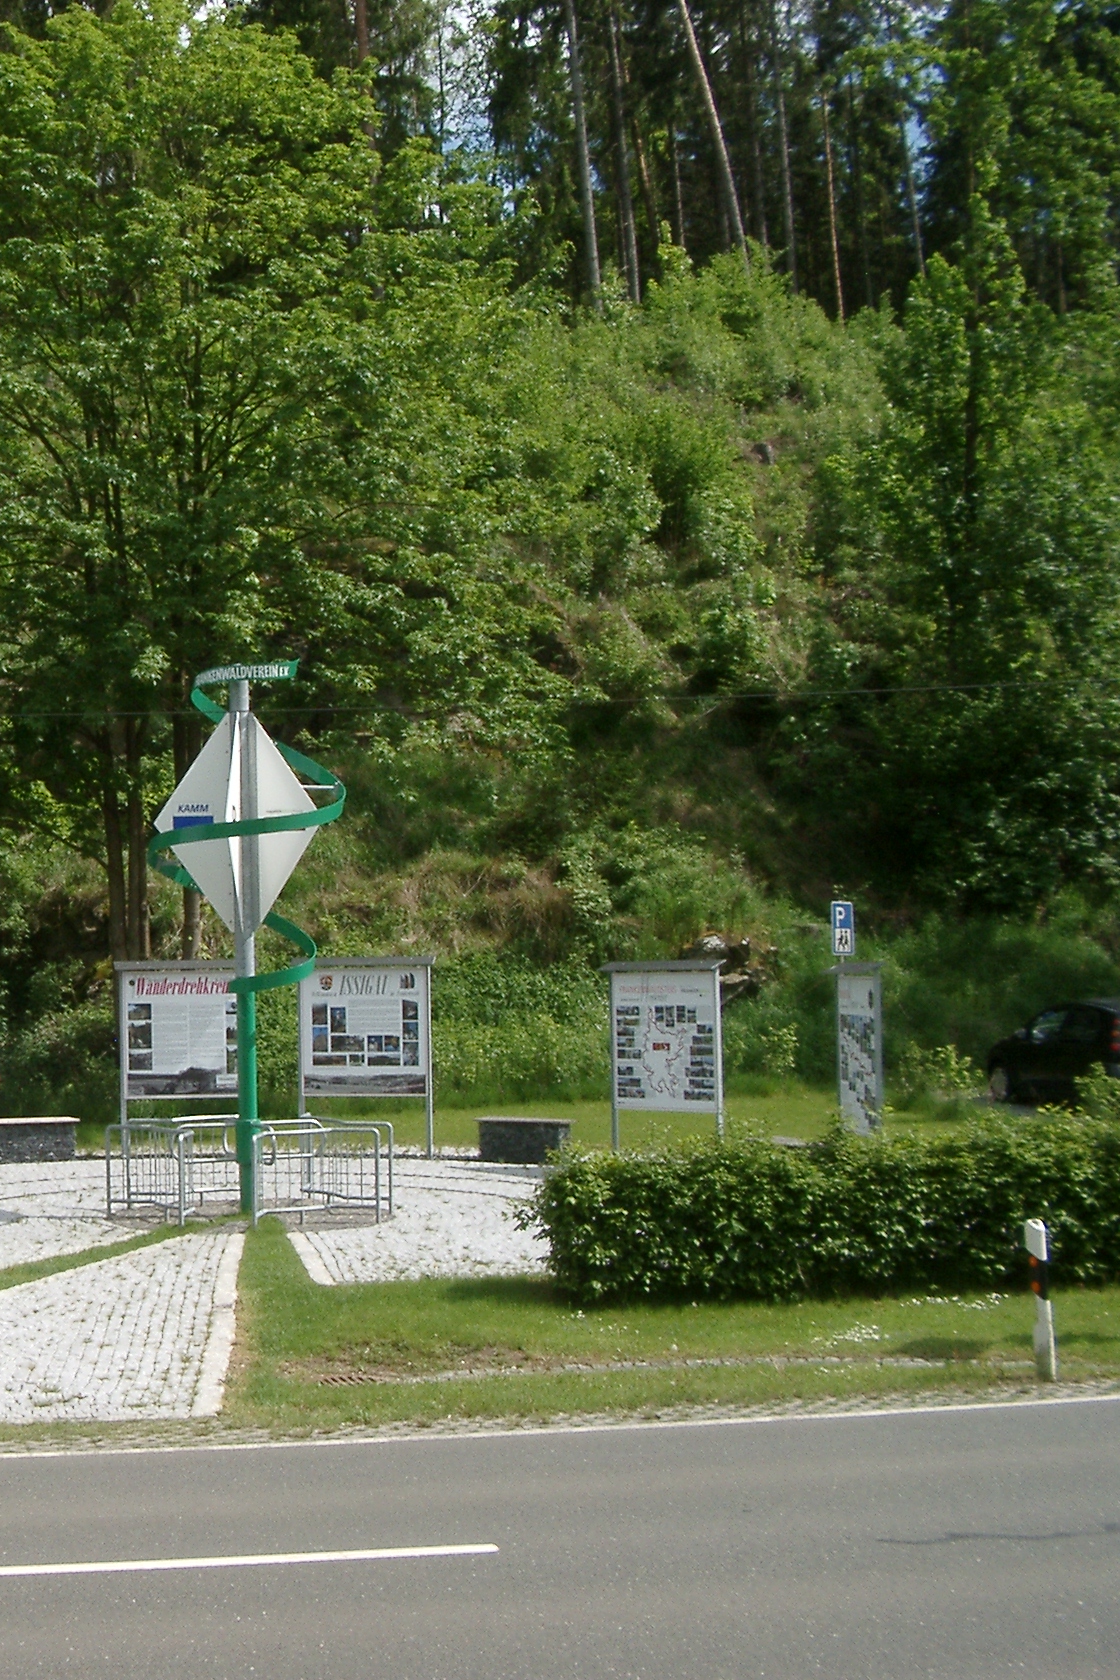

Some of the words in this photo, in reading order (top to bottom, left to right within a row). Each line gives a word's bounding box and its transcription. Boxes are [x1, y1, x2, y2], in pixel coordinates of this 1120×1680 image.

[178, 804, 209, 813] KAMM
[835, 907, 846, 928] P
[136, 976, 230, 995] Wanderdrehkreu
